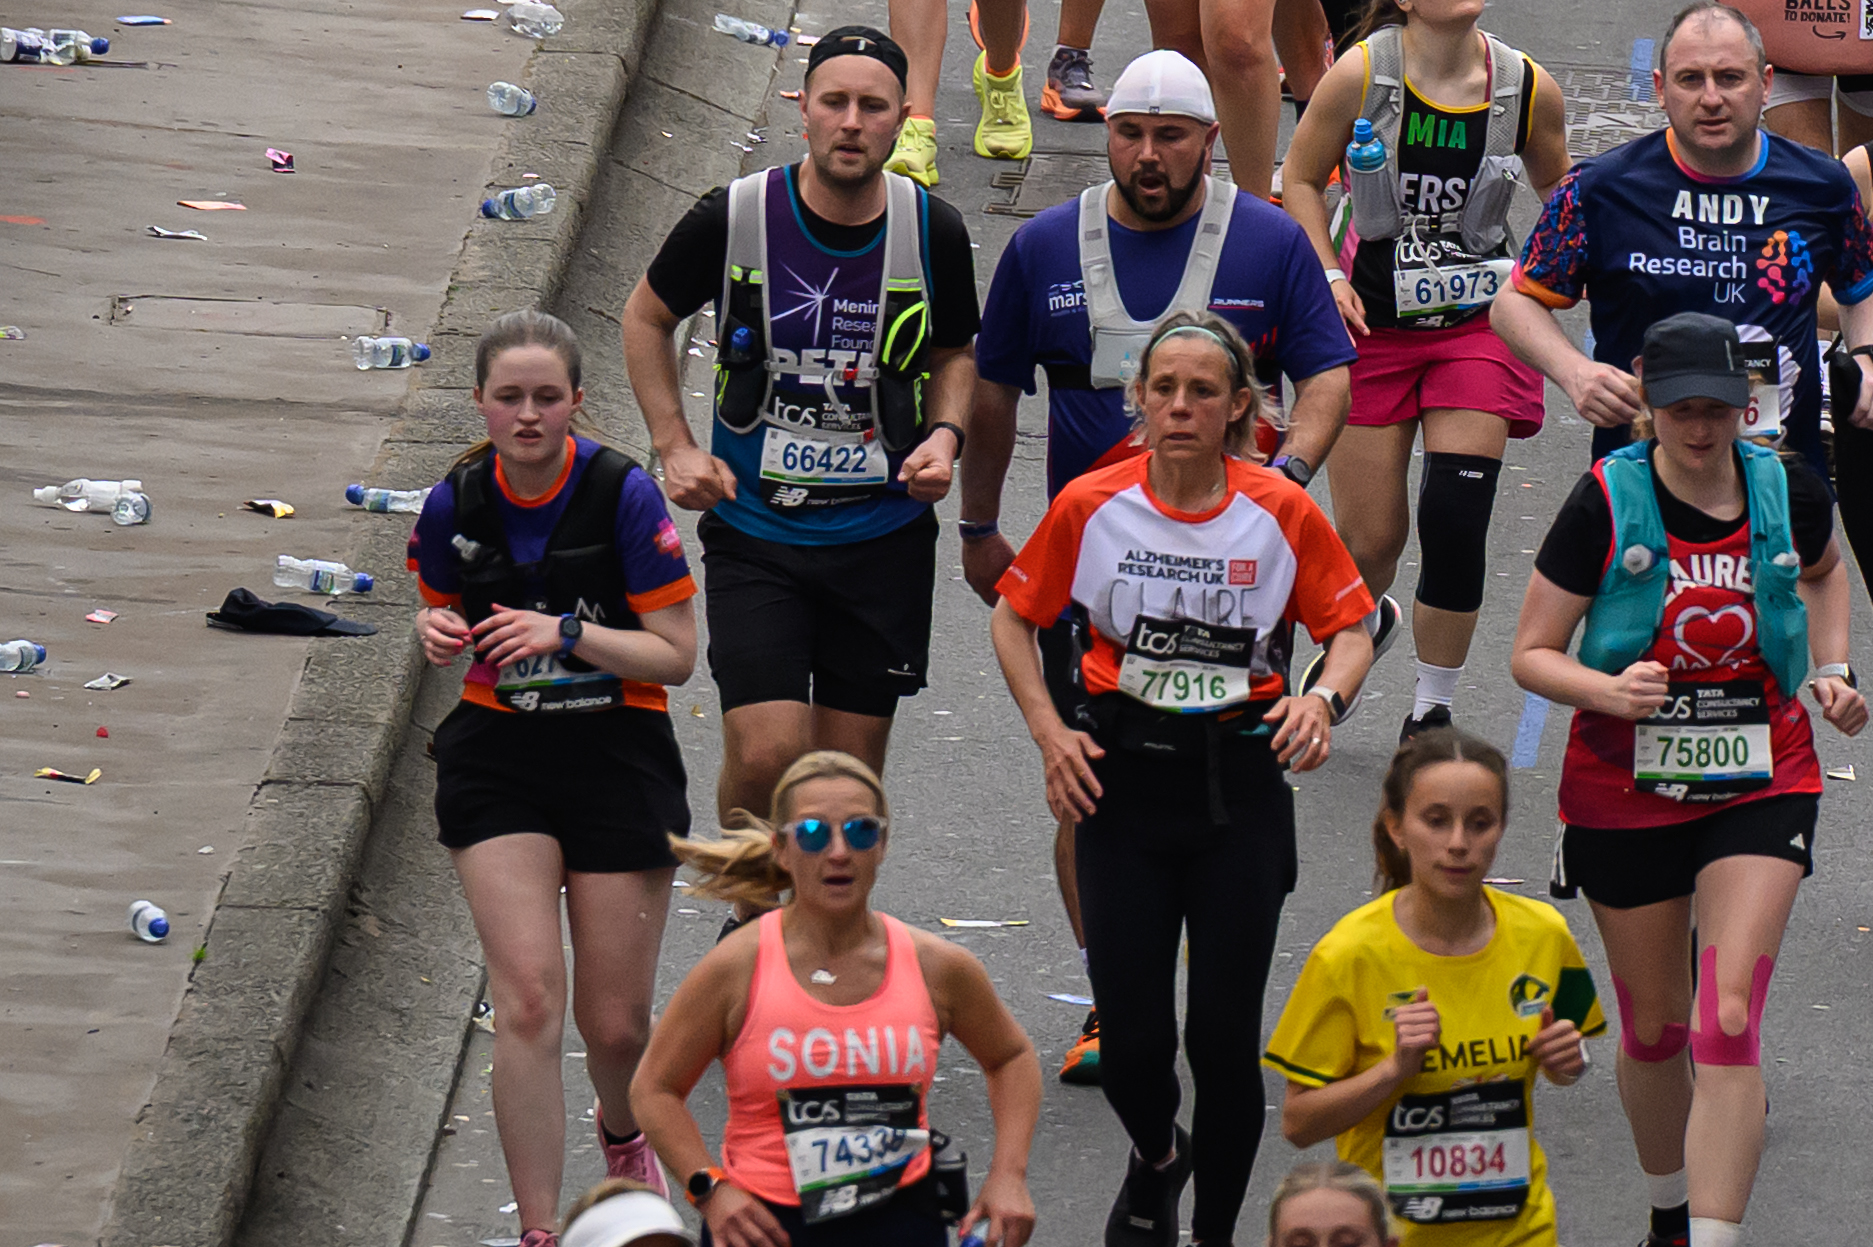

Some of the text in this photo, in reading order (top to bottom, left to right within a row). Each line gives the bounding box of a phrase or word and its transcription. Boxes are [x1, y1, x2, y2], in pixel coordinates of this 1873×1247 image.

[1784, 10, 1851, 23] TO DONATE!
[1407, 112, 1467, 150] MIA
[1672, 190, 1770, 225] ANDY
[1679, 226, 1747, 253] Brain
[1629, 253, 1747, 279] Research
[1415, 270, 1498, 307] 61973
[1714, 282, 1746, 304] UK
[775, 396, 817, 428] tcs
[782, 442, 868, 473] 66422
[1118, 562, 1200, 583] RESEARCH
[1204, 571, 1224, 585] UK
[1125, 549, 1225, 571] ALZHEIMER'S
[1136, 622, 1180, 654] tcs
[1140, 669, 1226, 701] 77916
[1696, 689, 1725, 698] TATA
[1658, 736, 1749, 767] 75800
[768, 1025, 927, 1081] SONIA
[1419, 1035, 1534, 1073] EMELIA
[787, 1099, 841, 1125] tcs
[1393, 1104, 1445, 1131] tcs
[1412, 1143, 1507, 1179] 10834
